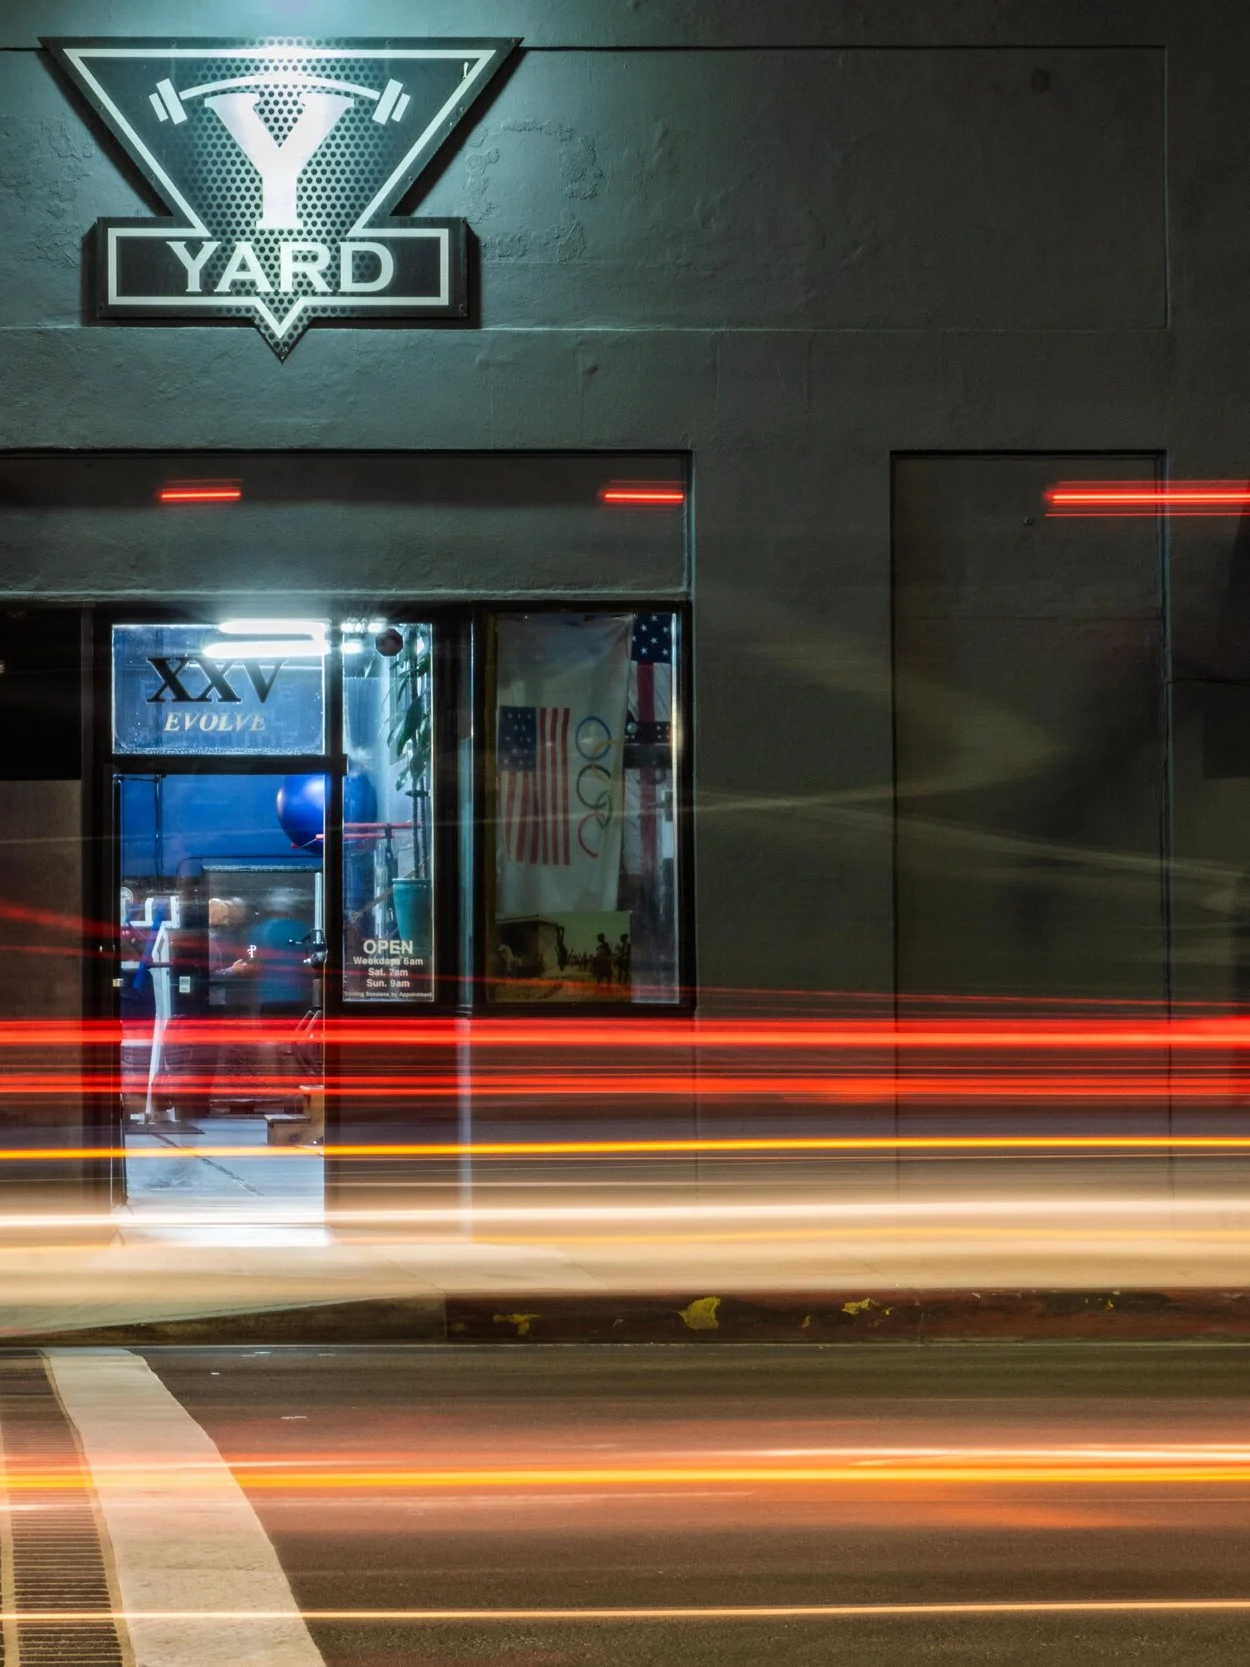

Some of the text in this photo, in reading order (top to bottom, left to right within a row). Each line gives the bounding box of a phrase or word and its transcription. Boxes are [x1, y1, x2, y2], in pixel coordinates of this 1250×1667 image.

[204, 91, 354, 230] Y
[166, 241, 394, 293] YARD
[146, 656, 288, 704] XXV
[163, 712, 267, 732] EVOLVE
[363, 939, 414, 955] OPEN
[352, 956, 424, 967] Weekdays 6am
[368, 967, 409, 977] Sat. 7am
[366, 978, 410, 988] Sun. 9am
